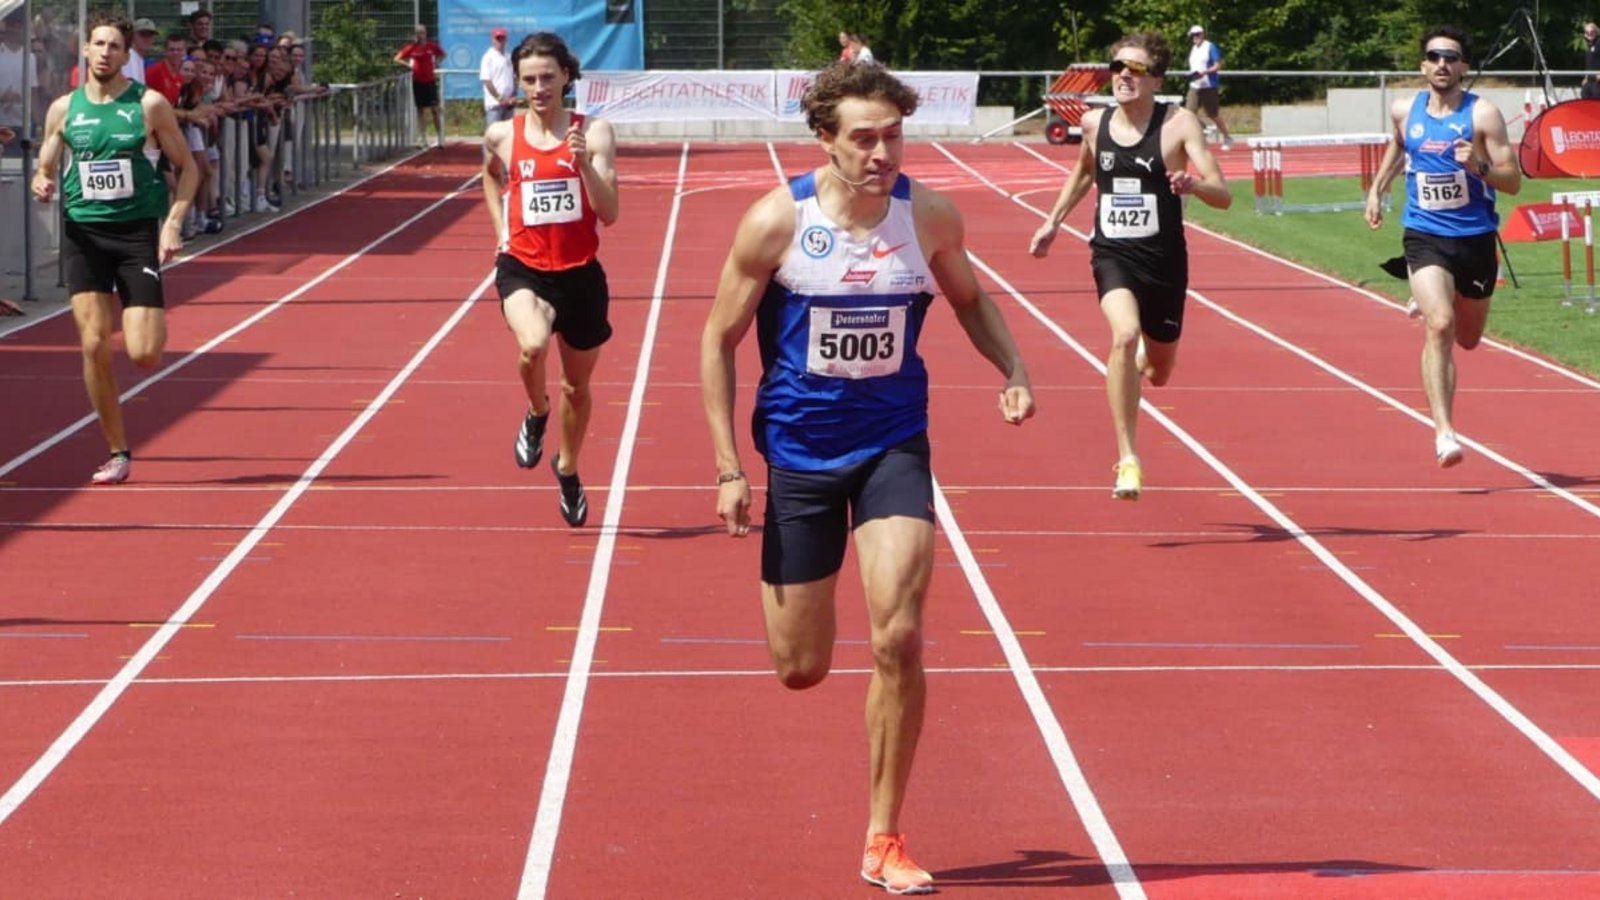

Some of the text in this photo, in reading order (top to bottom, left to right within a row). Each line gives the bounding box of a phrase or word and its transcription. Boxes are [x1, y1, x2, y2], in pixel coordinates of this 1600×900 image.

[87, 174, 125, 190] 4901
[1423, 184, 1463, 201] 5162
[529, 194, 575, 213] 4573
[1107, 210, 1150, 226] 4427
[820, 332, 894, 360] 5003
